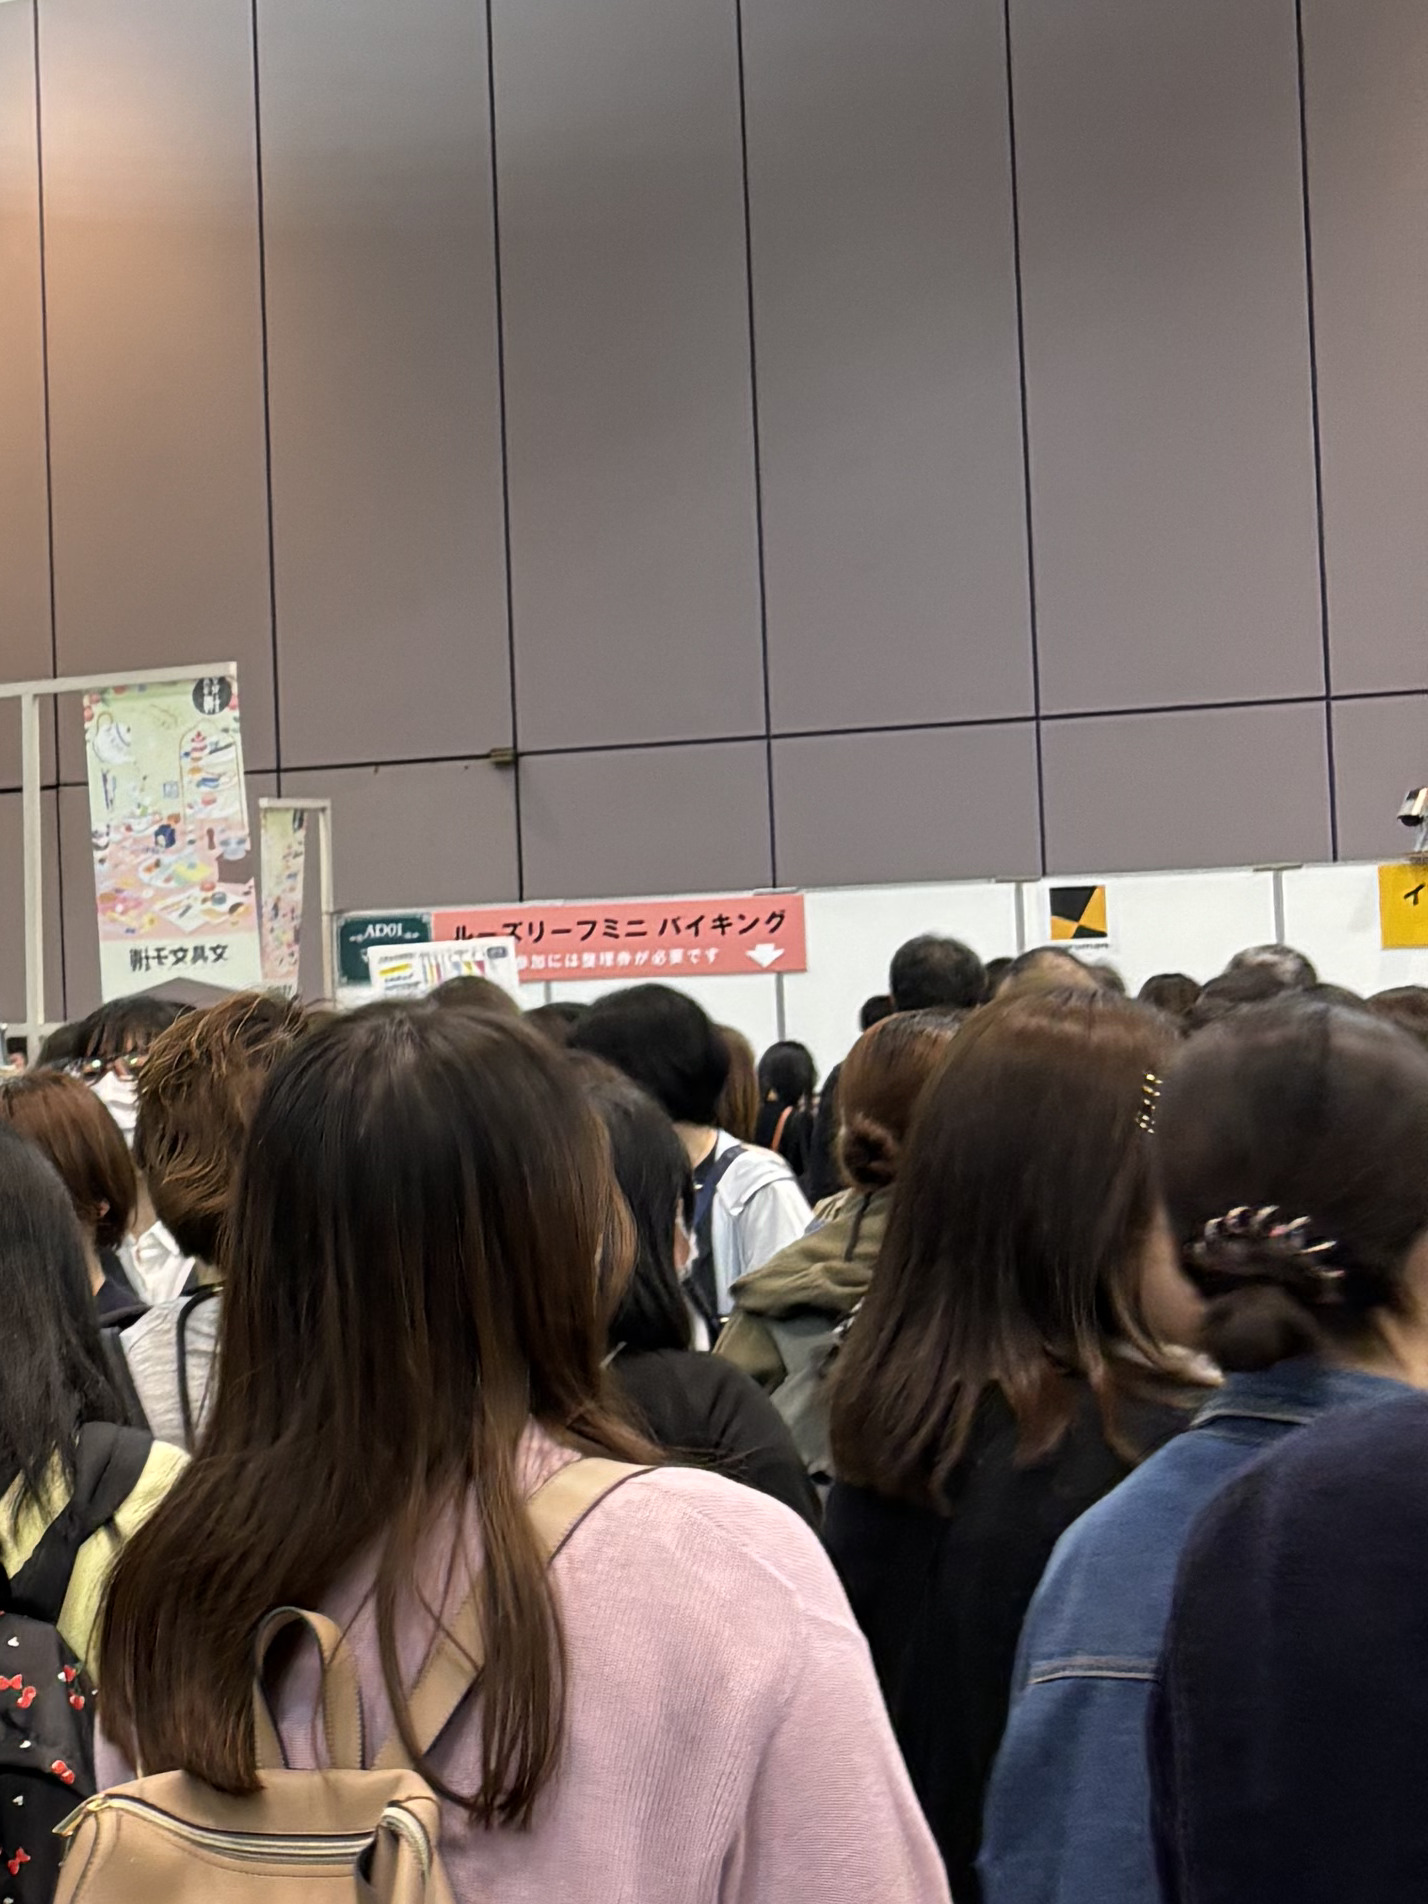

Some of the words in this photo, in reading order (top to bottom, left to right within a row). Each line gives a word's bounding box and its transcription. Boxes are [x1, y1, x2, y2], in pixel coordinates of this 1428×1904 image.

[364, 923, 404, 939] AD01
[454, 917, 648, 943] ルーズリーフミニ
[658, 908, 787, 938] バイキング
